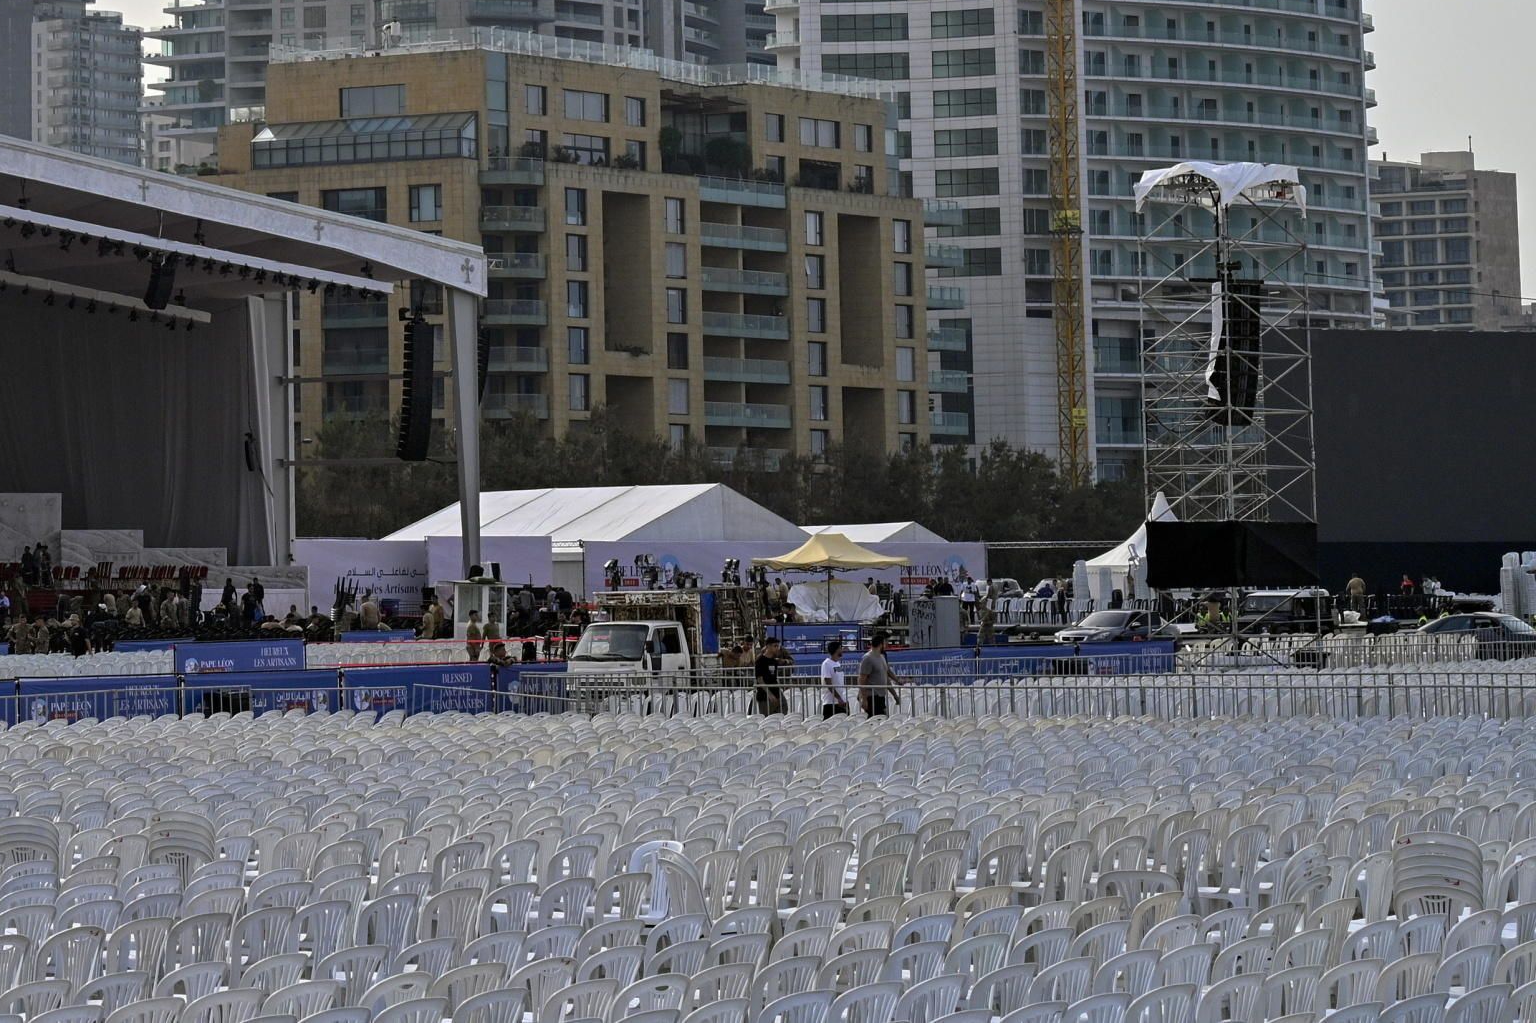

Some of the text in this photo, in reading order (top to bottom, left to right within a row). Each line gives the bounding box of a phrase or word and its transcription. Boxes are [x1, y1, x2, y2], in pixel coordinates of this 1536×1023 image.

[371, 583, 383, 594] les
[384, 583, 419, 594] Artisans
[442, 673, 473, 684] BLESSED
